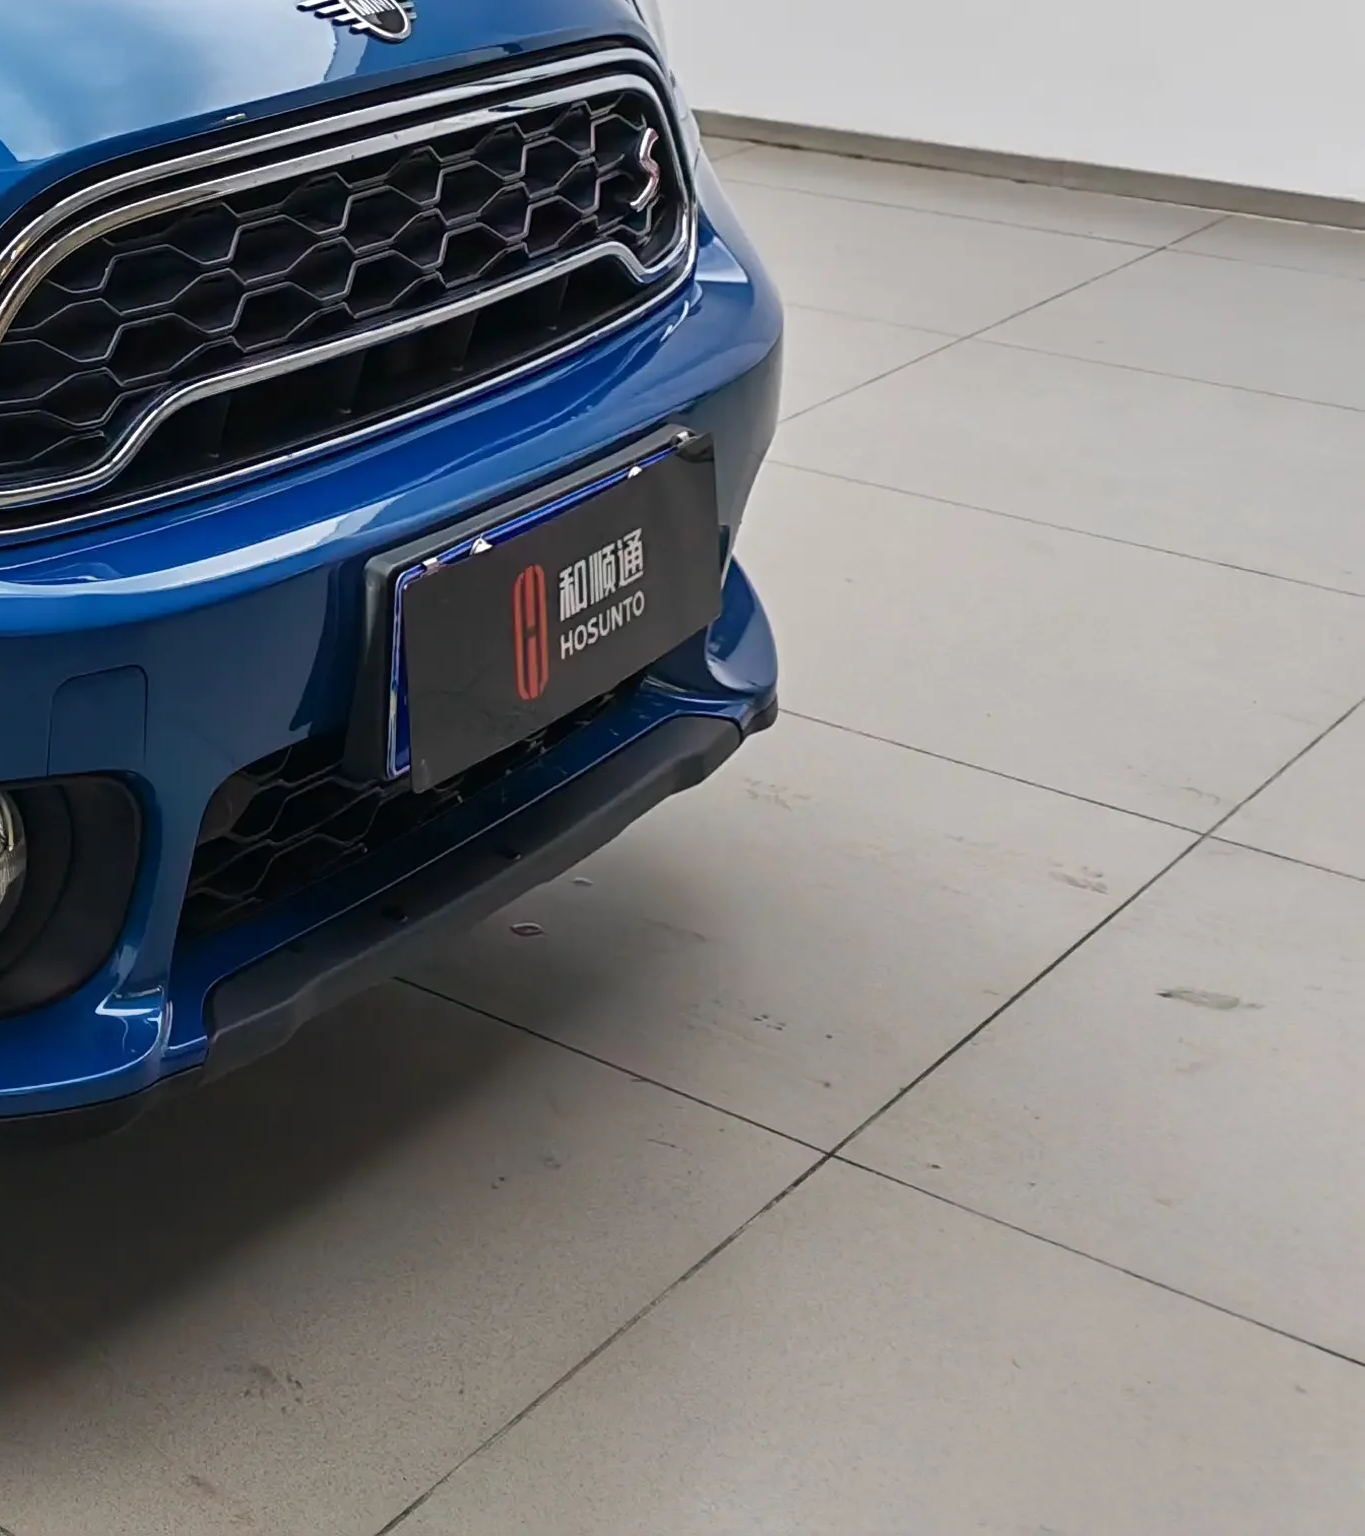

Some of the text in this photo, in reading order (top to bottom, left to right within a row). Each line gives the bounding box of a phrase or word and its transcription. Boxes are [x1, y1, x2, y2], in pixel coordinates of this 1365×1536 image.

[558, 527, 645, 622] 和顺通
[559, 590, 646, 660] HOSUNTO
